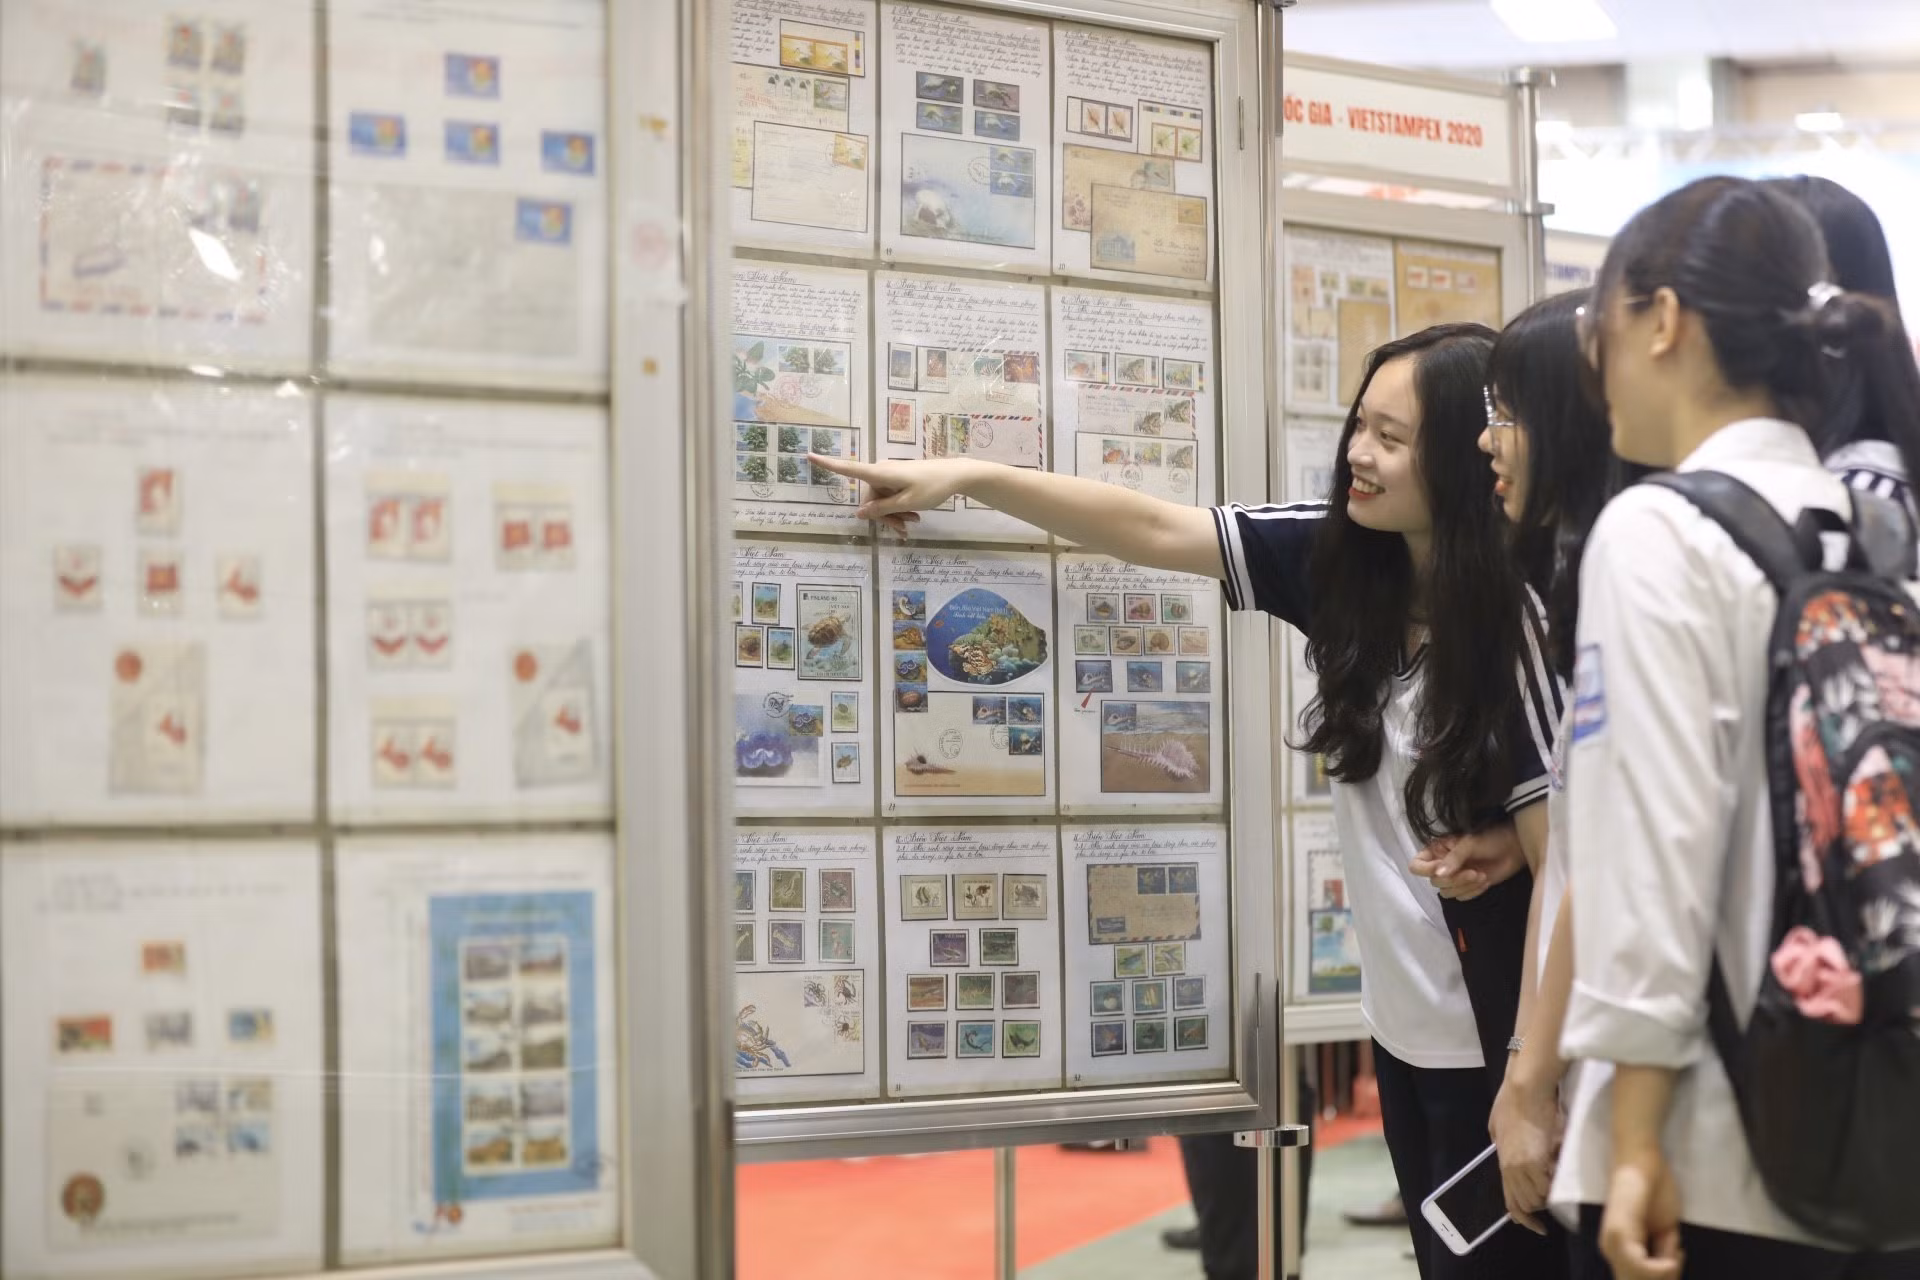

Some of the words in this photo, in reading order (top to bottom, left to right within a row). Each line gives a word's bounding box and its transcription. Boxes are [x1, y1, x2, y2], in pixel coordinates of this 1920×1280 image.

[1308, 100, 1332, 126] GIA
[1347, 106, 1442, 142] VIETSTAMPEX
[1447, 122, 1483, 147] 2020
